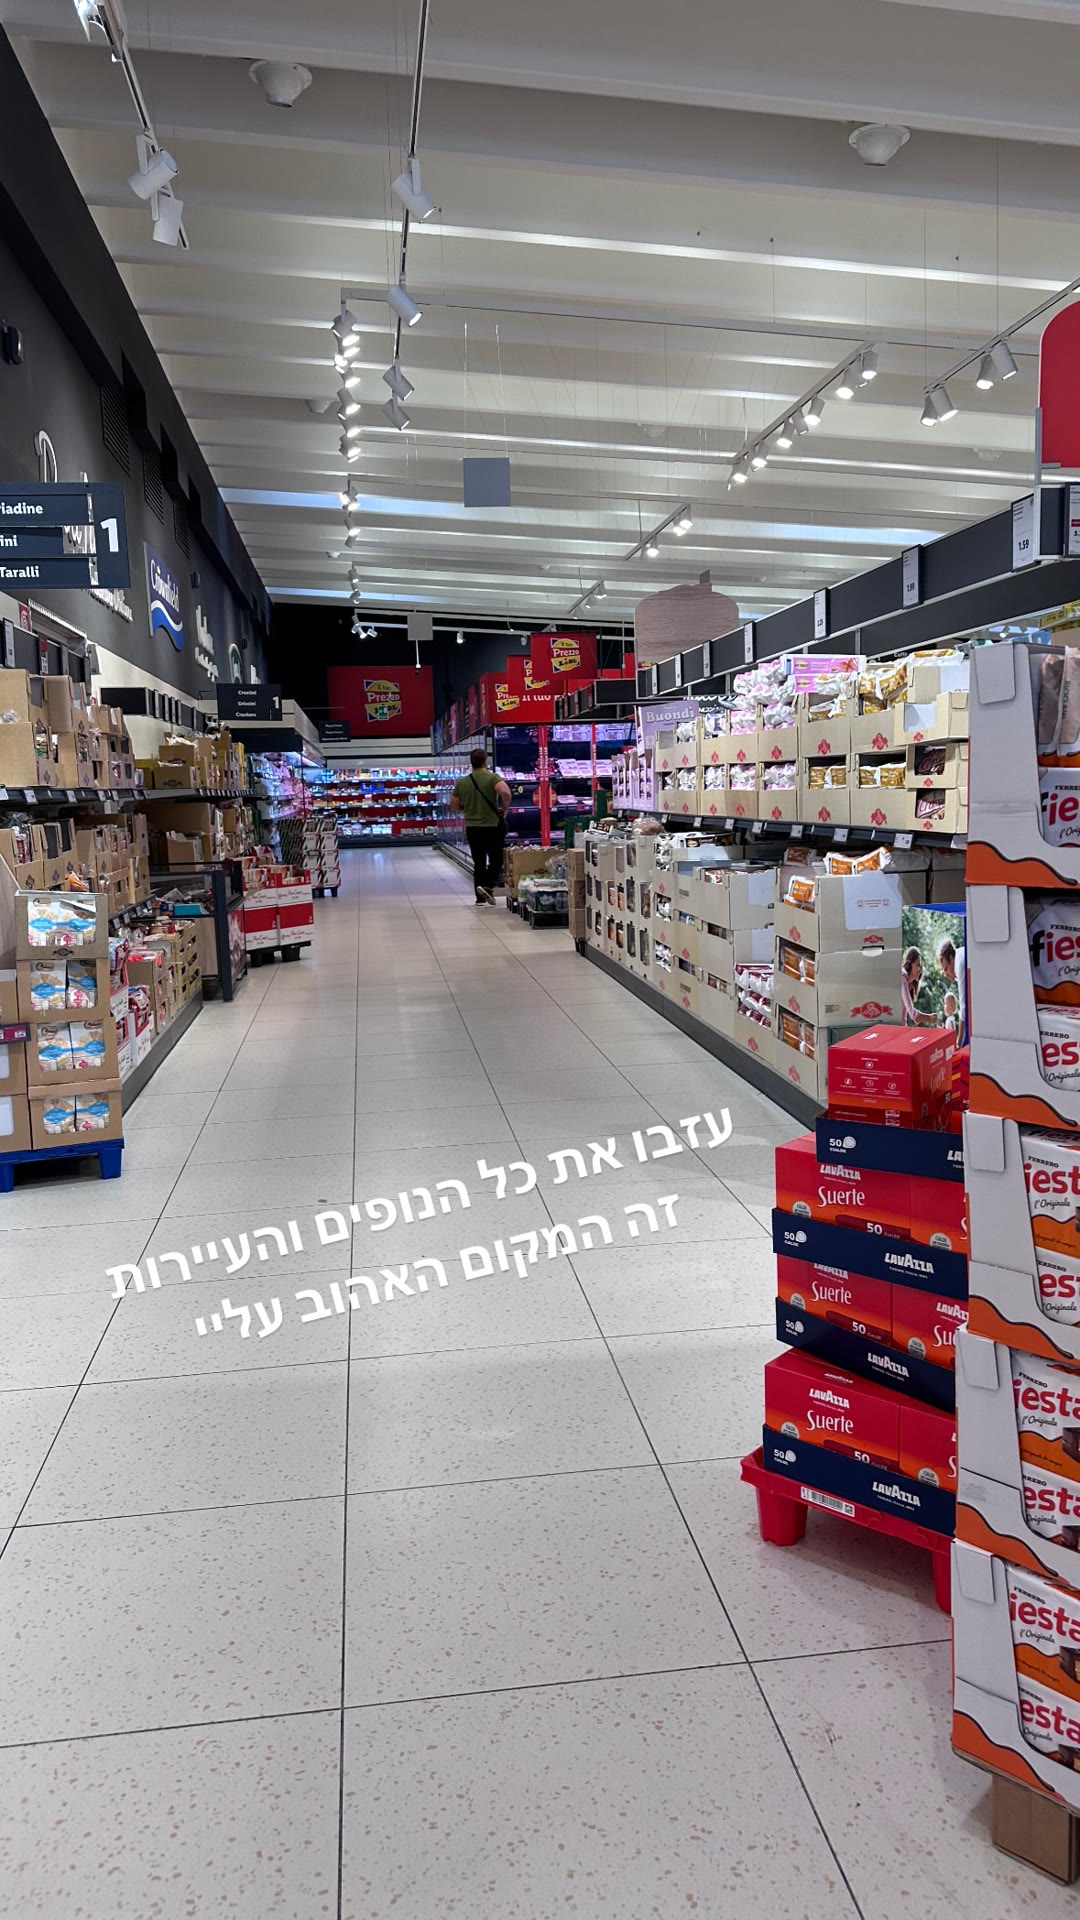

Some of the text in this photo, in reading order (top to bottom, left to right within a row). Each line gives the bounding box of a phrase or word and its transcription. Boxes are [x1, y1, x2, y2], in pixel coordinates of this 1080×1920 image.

[100, 518, 119, 552] 1
[553, 648, 579, 657] Prezzo
[272, 696, 280, 709] 1
[366, 691, 400, 703] Prezzo
[645, 706, 695, 723] Buondì
[829, 1138, 842, 1148] 50
[1028, 1155, 1059, 1168] FERRERO
[819, 1164, 861, 1181] LAVAZZA
[817, 1185, 865, 1208] Suerte
[784, 1231, 795, 1241] 50
[866, 1222, 883, 1235] 50
[885, 1252, 934, 1274] LAVAZZA
[811, 1280, 852, 1305] Suerte
[785, 1319, 795, 1330] 50
[852, 1321, 866, 1335] 50
[868, 1352, 909, 1378] LAVAZZA
[1018, 1371, 1048, 1388] FERRERO
[808, 1388, 850, 1409] LAVAZZA
[806, 1410, 854, 1435] Suerte
[773, 1448, 785, 1459] 50
[854, 1450, 870, 1464] 50
[872, 1481, 921, 1507] LAVAZZA
[1013, 1585, 1046, 1605] FERRERO
